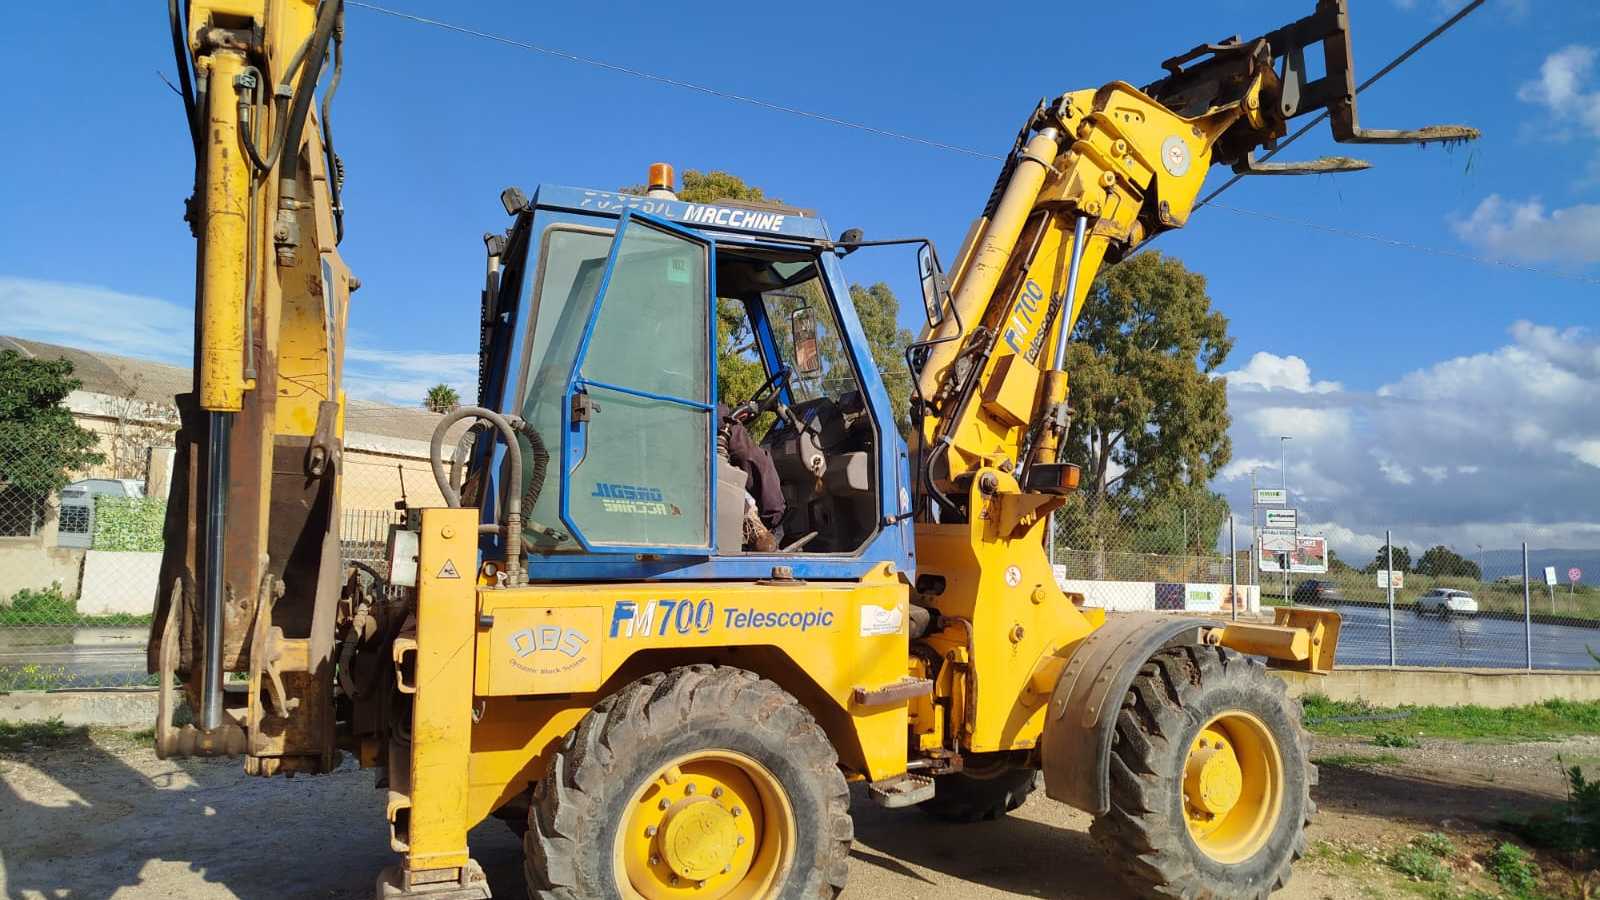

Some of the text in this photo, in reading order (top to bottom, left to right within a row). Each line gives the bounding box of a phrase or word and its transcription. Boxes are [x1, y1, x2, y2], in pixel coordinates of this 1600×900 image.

[683, 204, 784, 231] MACCHINE
[609, 598, 833, 638] FM700 Telescopic
